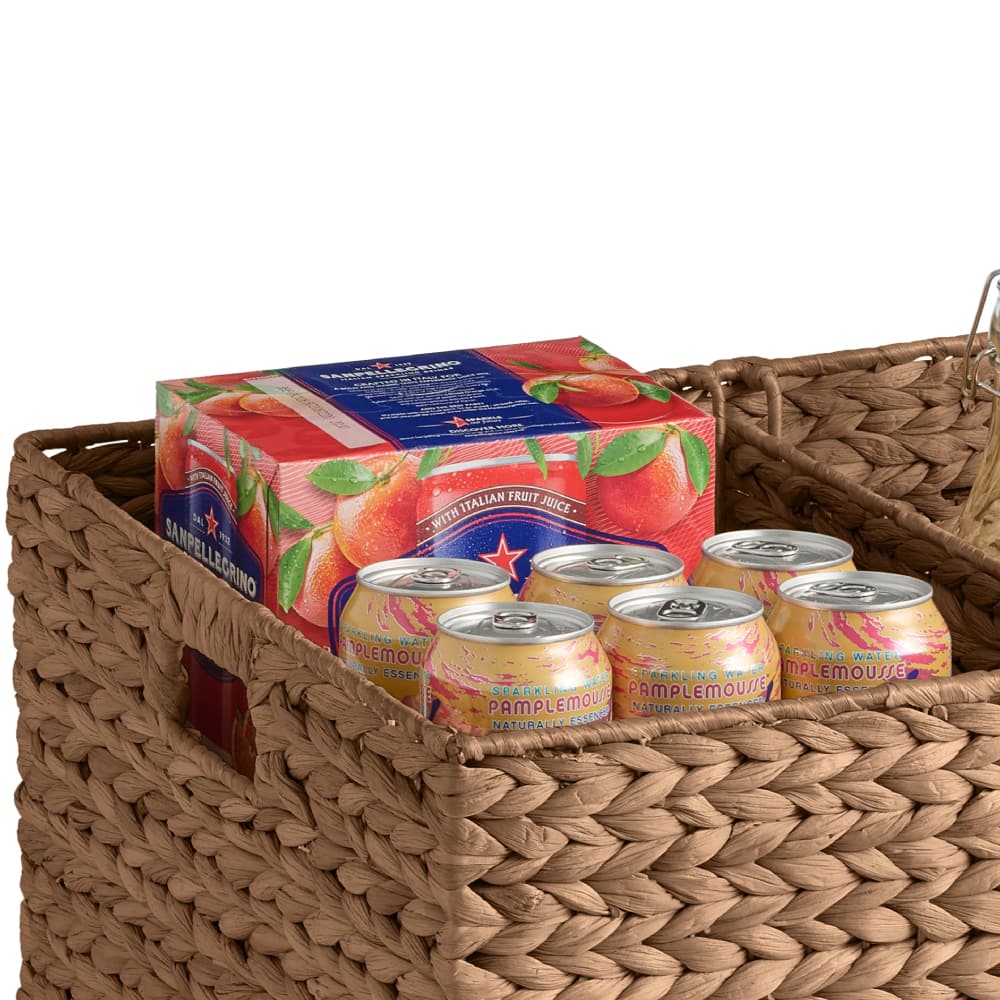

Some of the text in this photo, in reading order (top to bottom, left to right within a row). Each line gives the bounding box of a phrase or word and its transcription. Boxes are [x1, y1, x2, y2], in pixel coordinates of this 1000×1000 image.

[319, 360, 462, 379] SANPELLEGRINO
[192, 512, 205, 527] DAL
[431, 491, 572, 530] WITH ITALIAN FRUIT JUICE
[165, 517, 257, 599] SANPELLEGRINO
[399, 636, 433, 647] WAT
[383, 668, 420, 680] ESSEN
[781, 658, 906, 680] MPLEMOUSSE
[628, 675, 767, 699] PAMPLEMOUSSE
[488, 684, 611, 716] PAMPLEMOUSSE
[492, 718, 565, 731] NATURALLY
